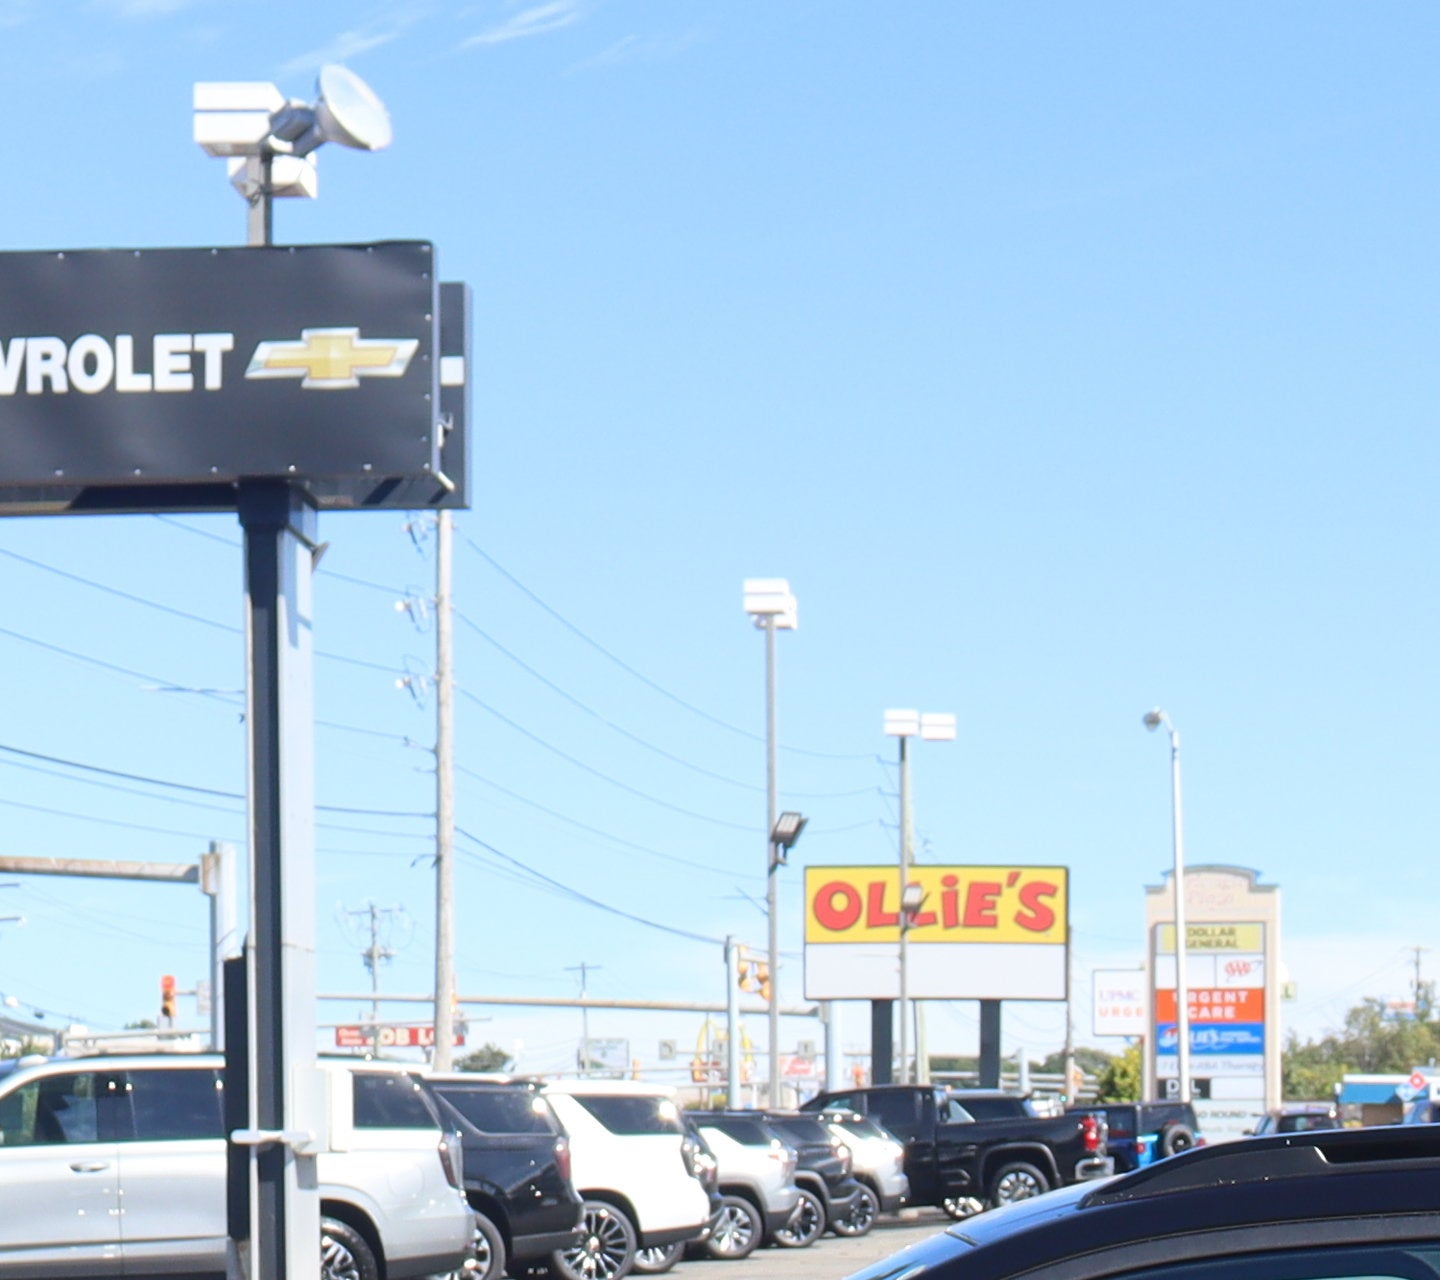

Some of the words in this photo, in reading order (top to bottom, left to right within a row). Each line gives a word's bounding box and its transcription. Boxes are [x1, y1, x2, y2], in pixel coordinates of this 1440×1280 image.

[1187, 926, 1237, 938] DOLLAR
[1185, 938, 1238, 950] GENERAL
[1172, 990, 1249, 1004] RGENT
[1187, 1005, 1236, 1019] CARE
[1166, 1079, 1202, 1094] DL
